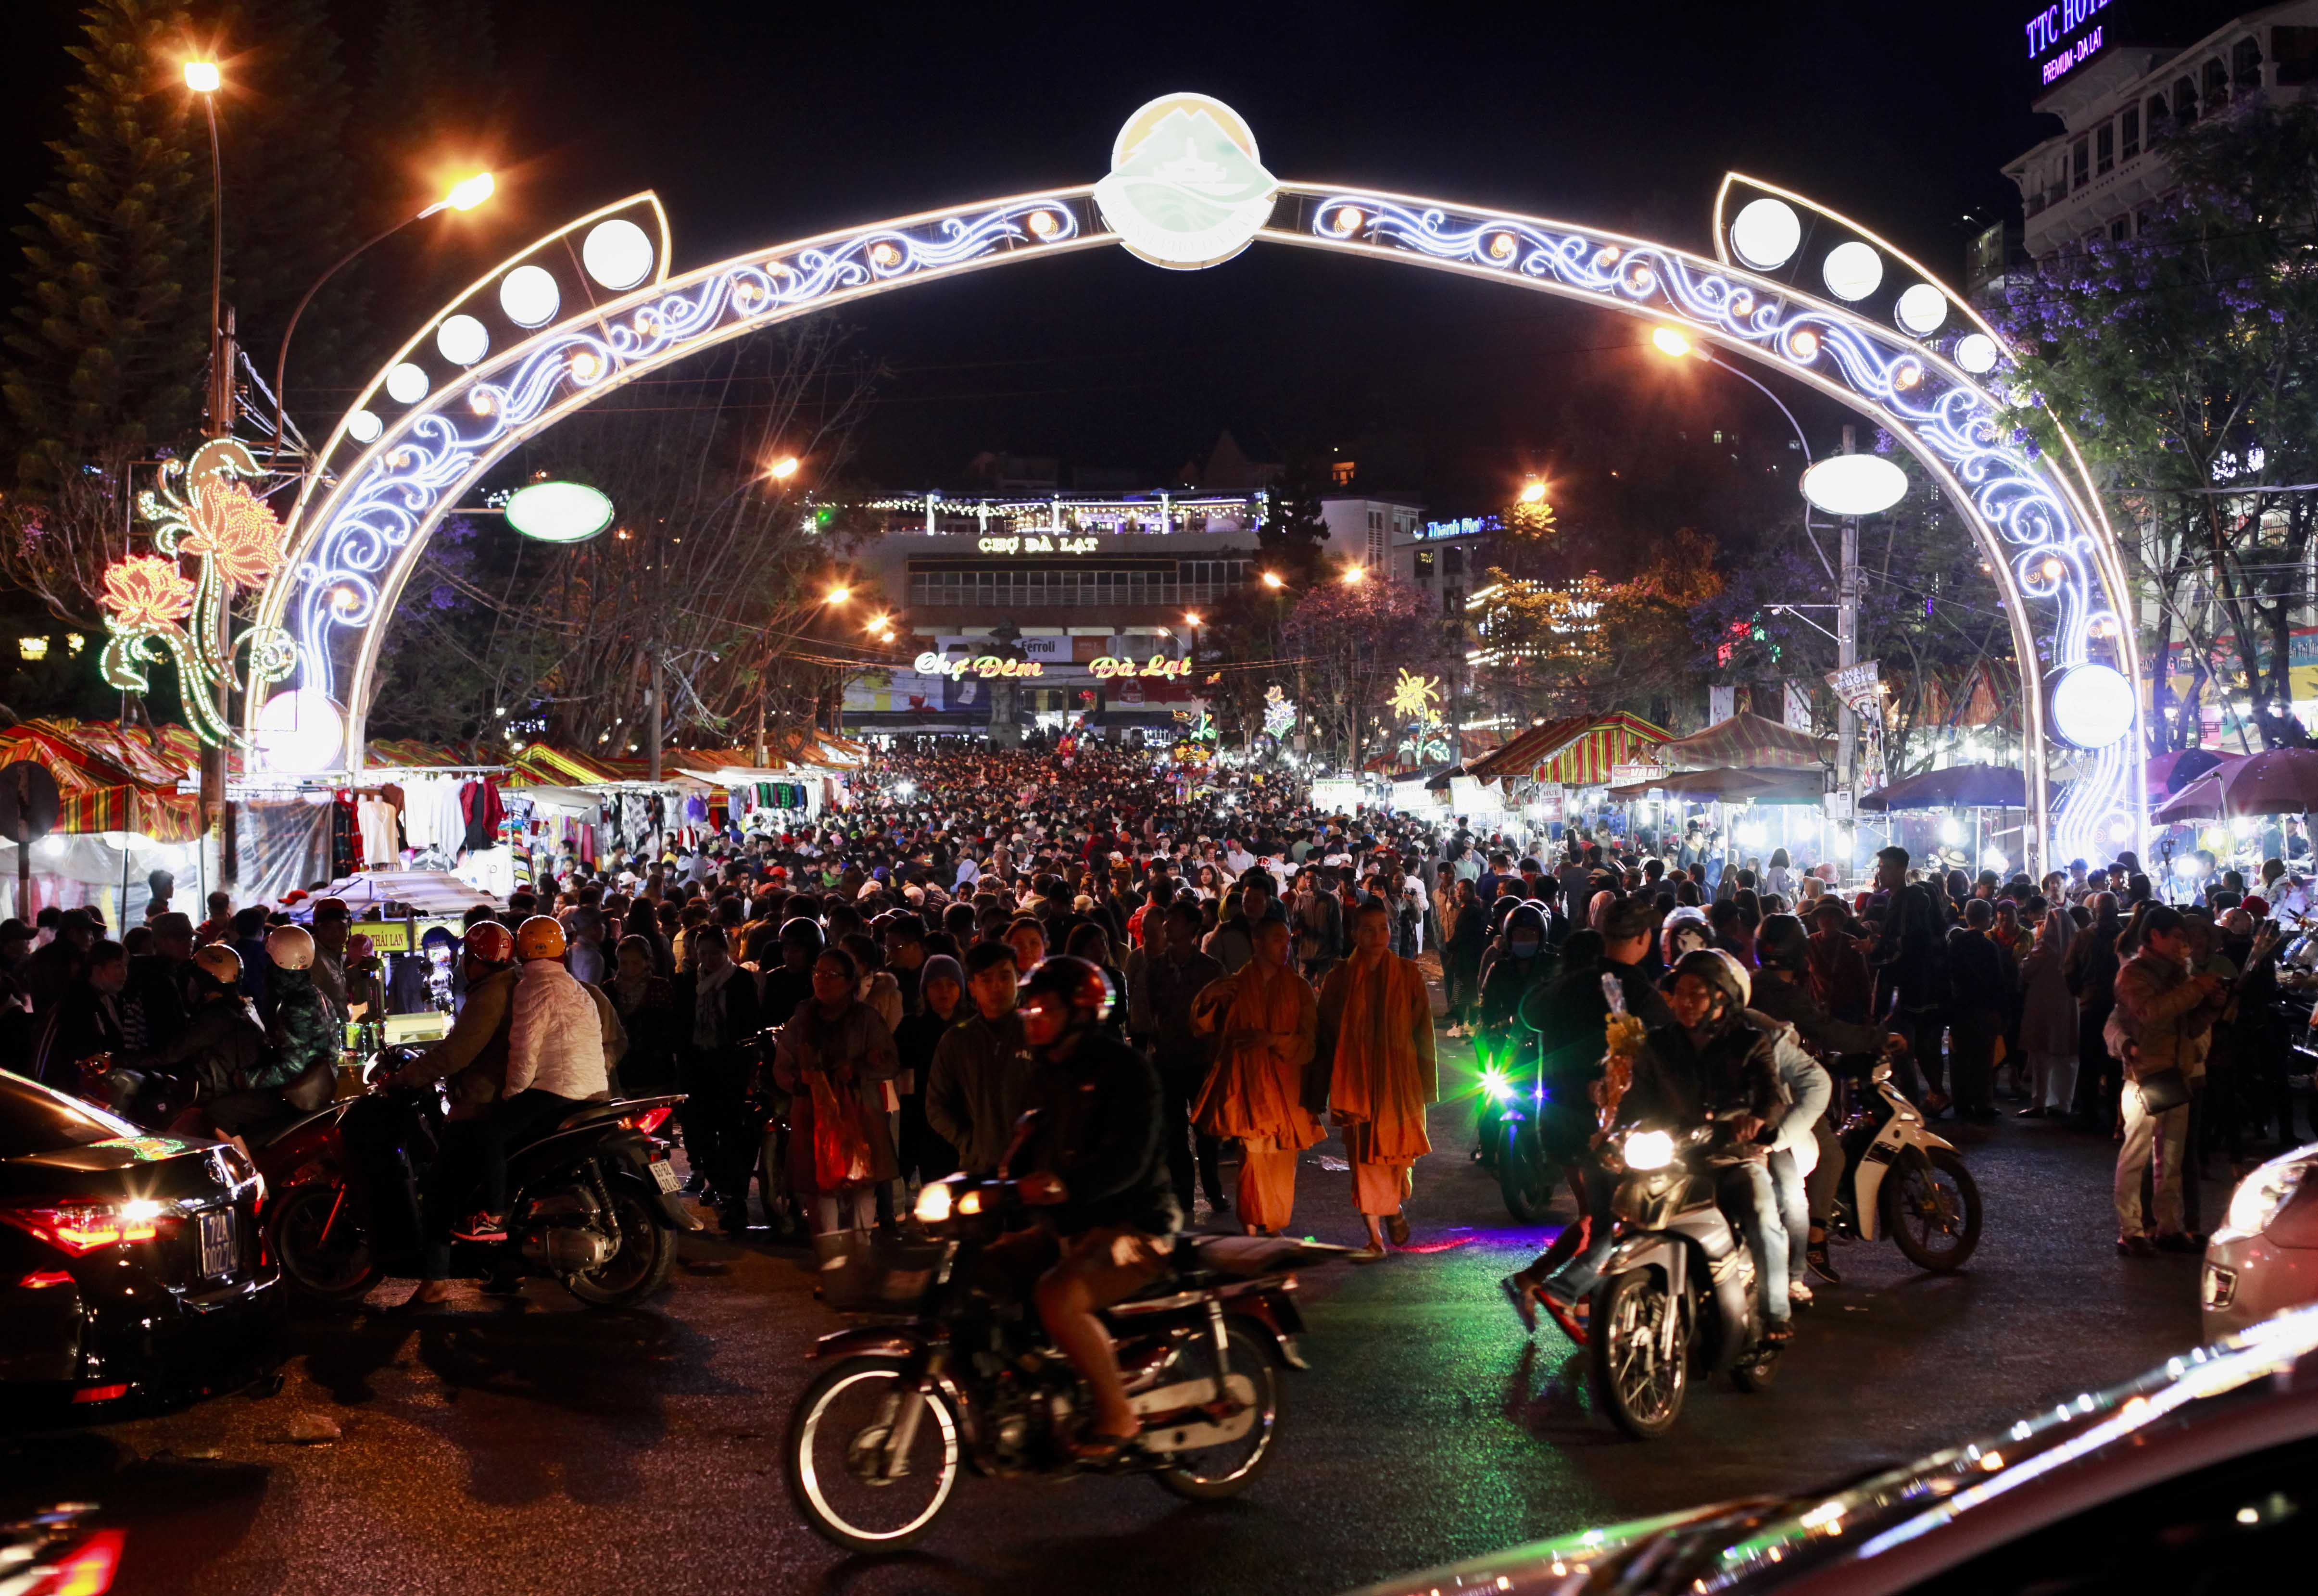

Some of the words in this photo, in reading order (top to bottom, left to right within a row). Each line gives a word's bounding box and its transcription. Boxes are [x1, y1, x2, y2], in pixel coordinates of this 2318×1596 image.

[2026, 4, 2059, 58] TTC
[2043, 49, 2074, 85] PREMIUM
[2089, 26, 2102, 53] LAT
[1427, 519, 1460, 538] Thanh
[978, 535, 1020, 555] CHỢ
[1024, 535, 1054, 552] ĐÀ
[1059, 537, 1099, 555] LẠT
[1022, 641, 1055, 653] Ferroli
[914, 652, 970, 681] Chợ
[972, 655, 1044, 678] Đêm
[1088, 656, 1137, 679] Đà
[1139, 654, 1193, 680] Lạt
[1838, 666, 1864, 680] KHAI
[1631, 767, 1658, 777] VÂN
[371, 931, 388, 946] THÁI
[391, 933, 403, 946] LAN
[209, 1214, 229, 1244] 72A
